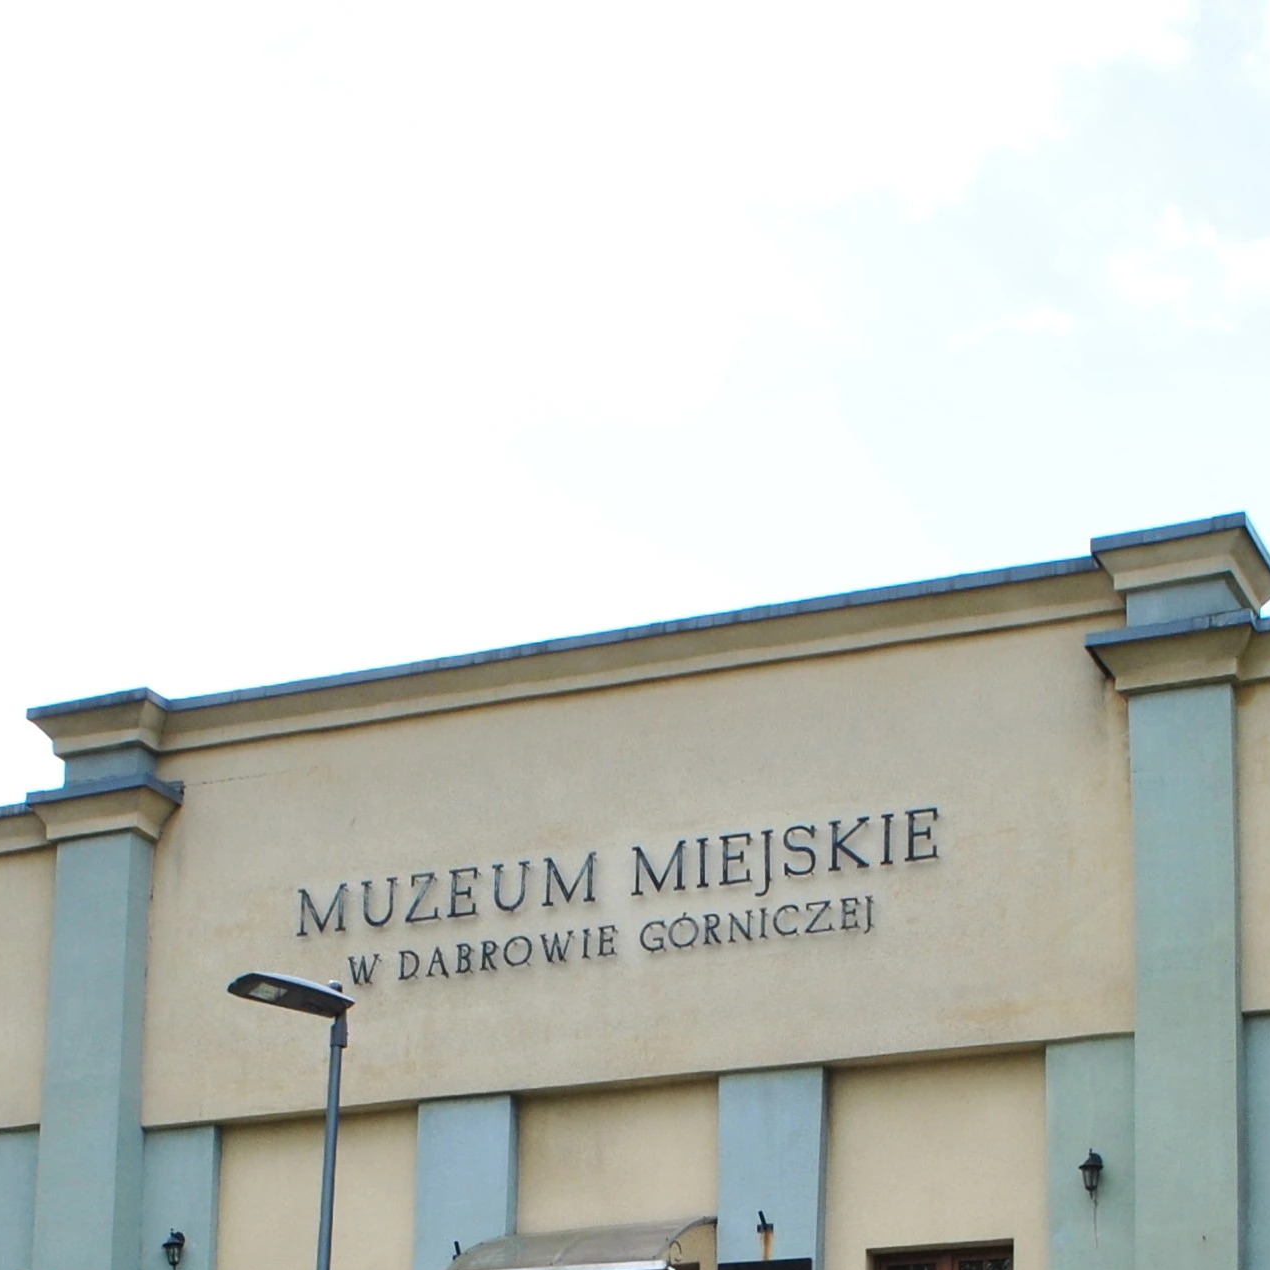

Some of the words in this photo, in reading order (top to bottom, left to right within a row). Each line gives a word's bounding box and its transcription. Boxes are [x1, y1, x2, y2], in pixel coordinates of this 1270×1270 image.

[297, 851, 597, 936] MUZEUM
[631, 808, 939, 896] MIEJSKIE
[348, 953, 381, 985] W
[639, 895, 874, 952] GÓRNICZEJ
